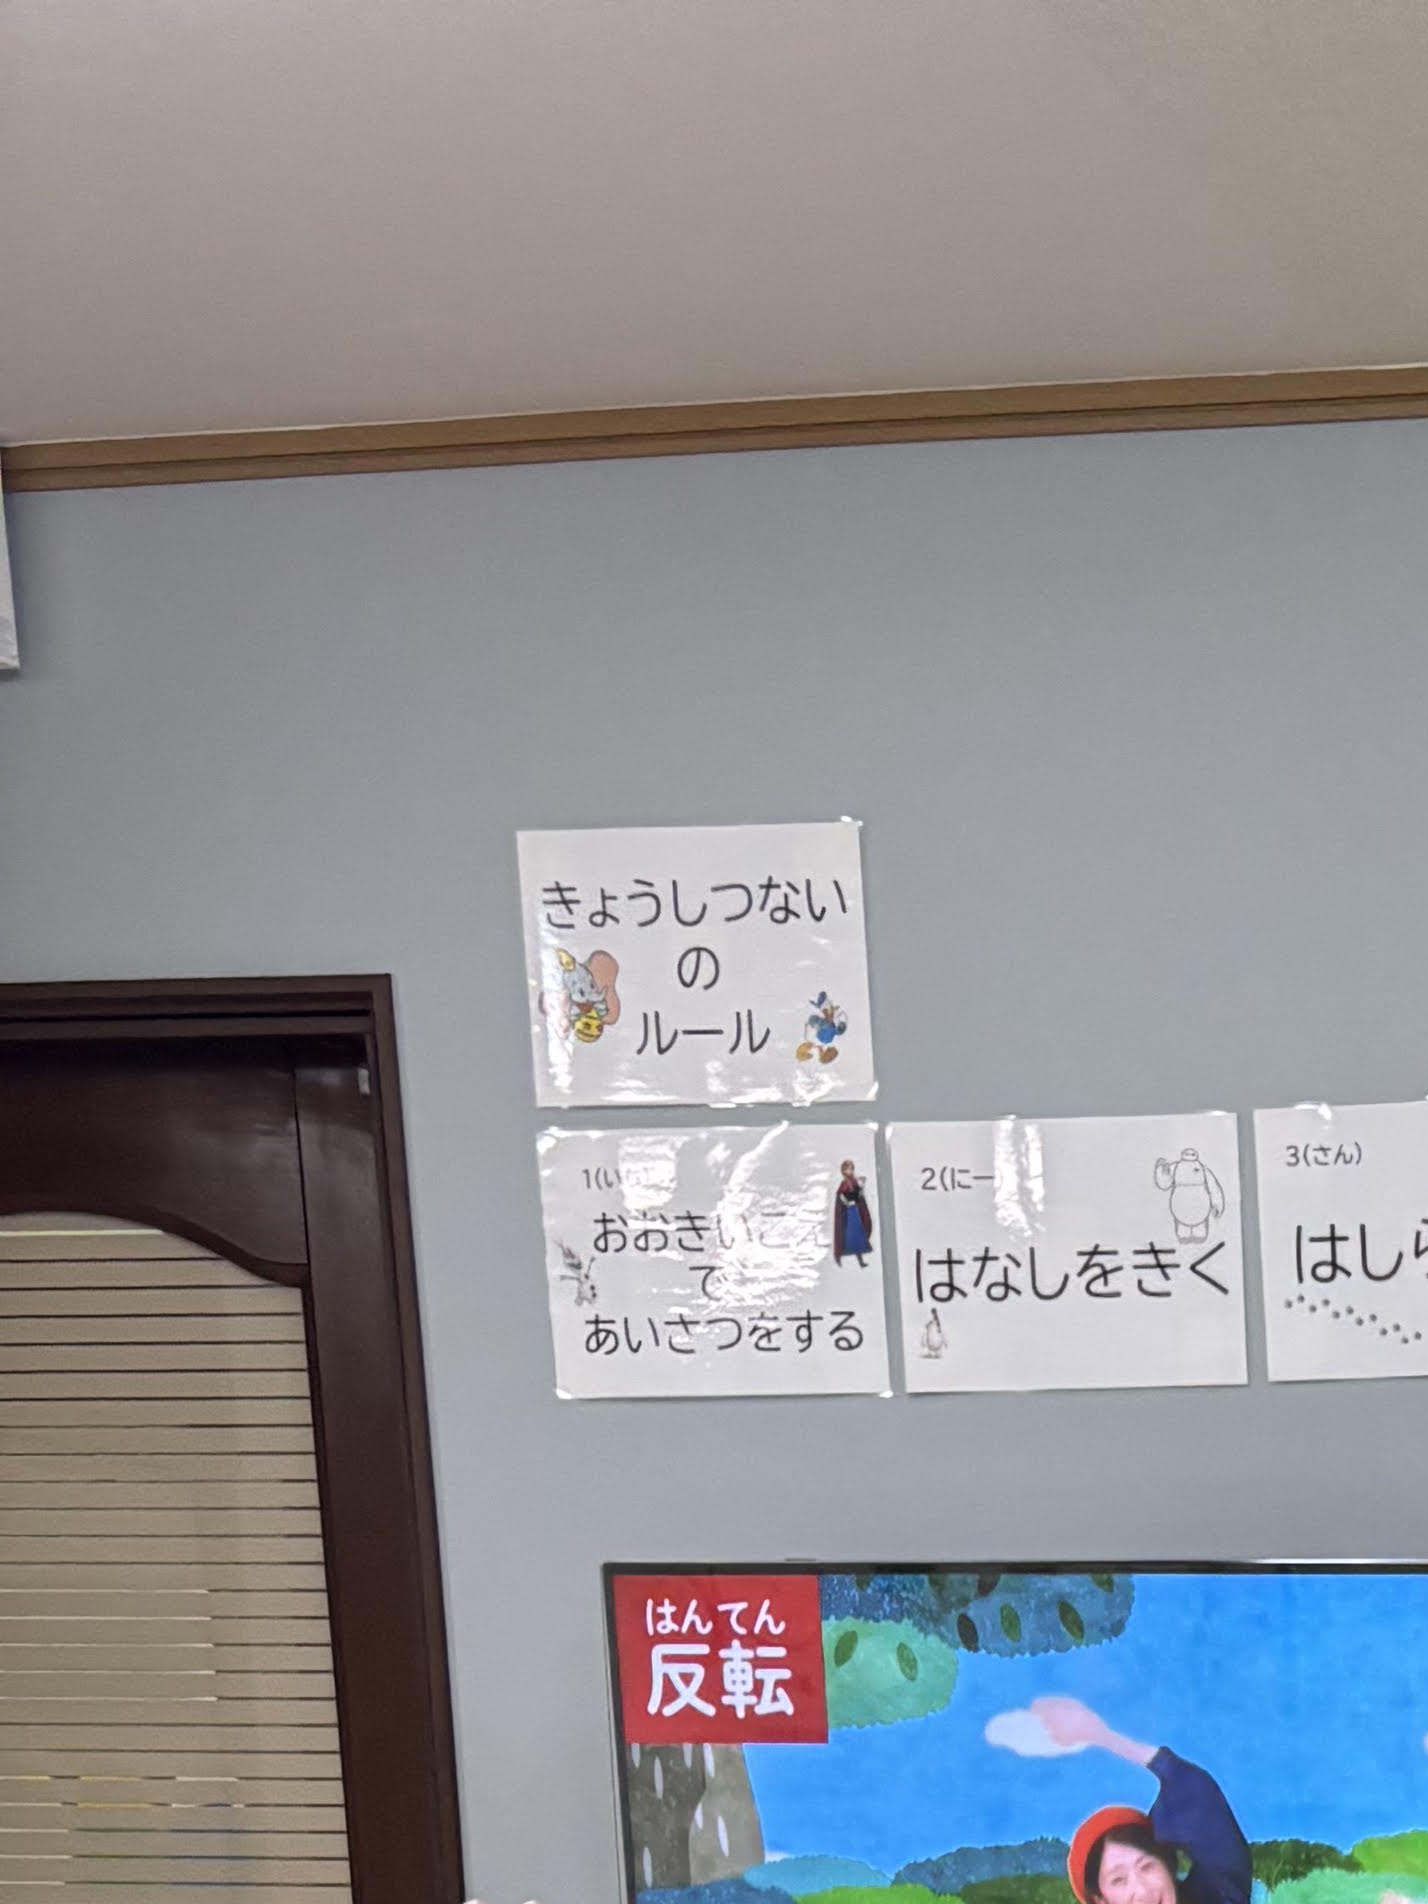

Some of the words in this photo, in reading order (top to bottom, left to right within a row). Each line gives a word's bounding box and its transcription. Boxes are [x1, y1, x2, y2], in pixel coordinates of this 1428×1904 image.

[542, 875, 848, 929] きょうしつない
[677, 947, 720, 991] の
[636, 1008, 771, 1056] ルール
[1284, 1141, 1363, 1168] 3(さん)
[920, 1166, 996, 1192] 2(にー
[915, 1240, 1230, 1304] はなしをきく
[584, 1308, 864, 1355] あいさつをする
[644, 1597, 786, 1636] はんてん
[646, 1639, 795, 1720] 反転
